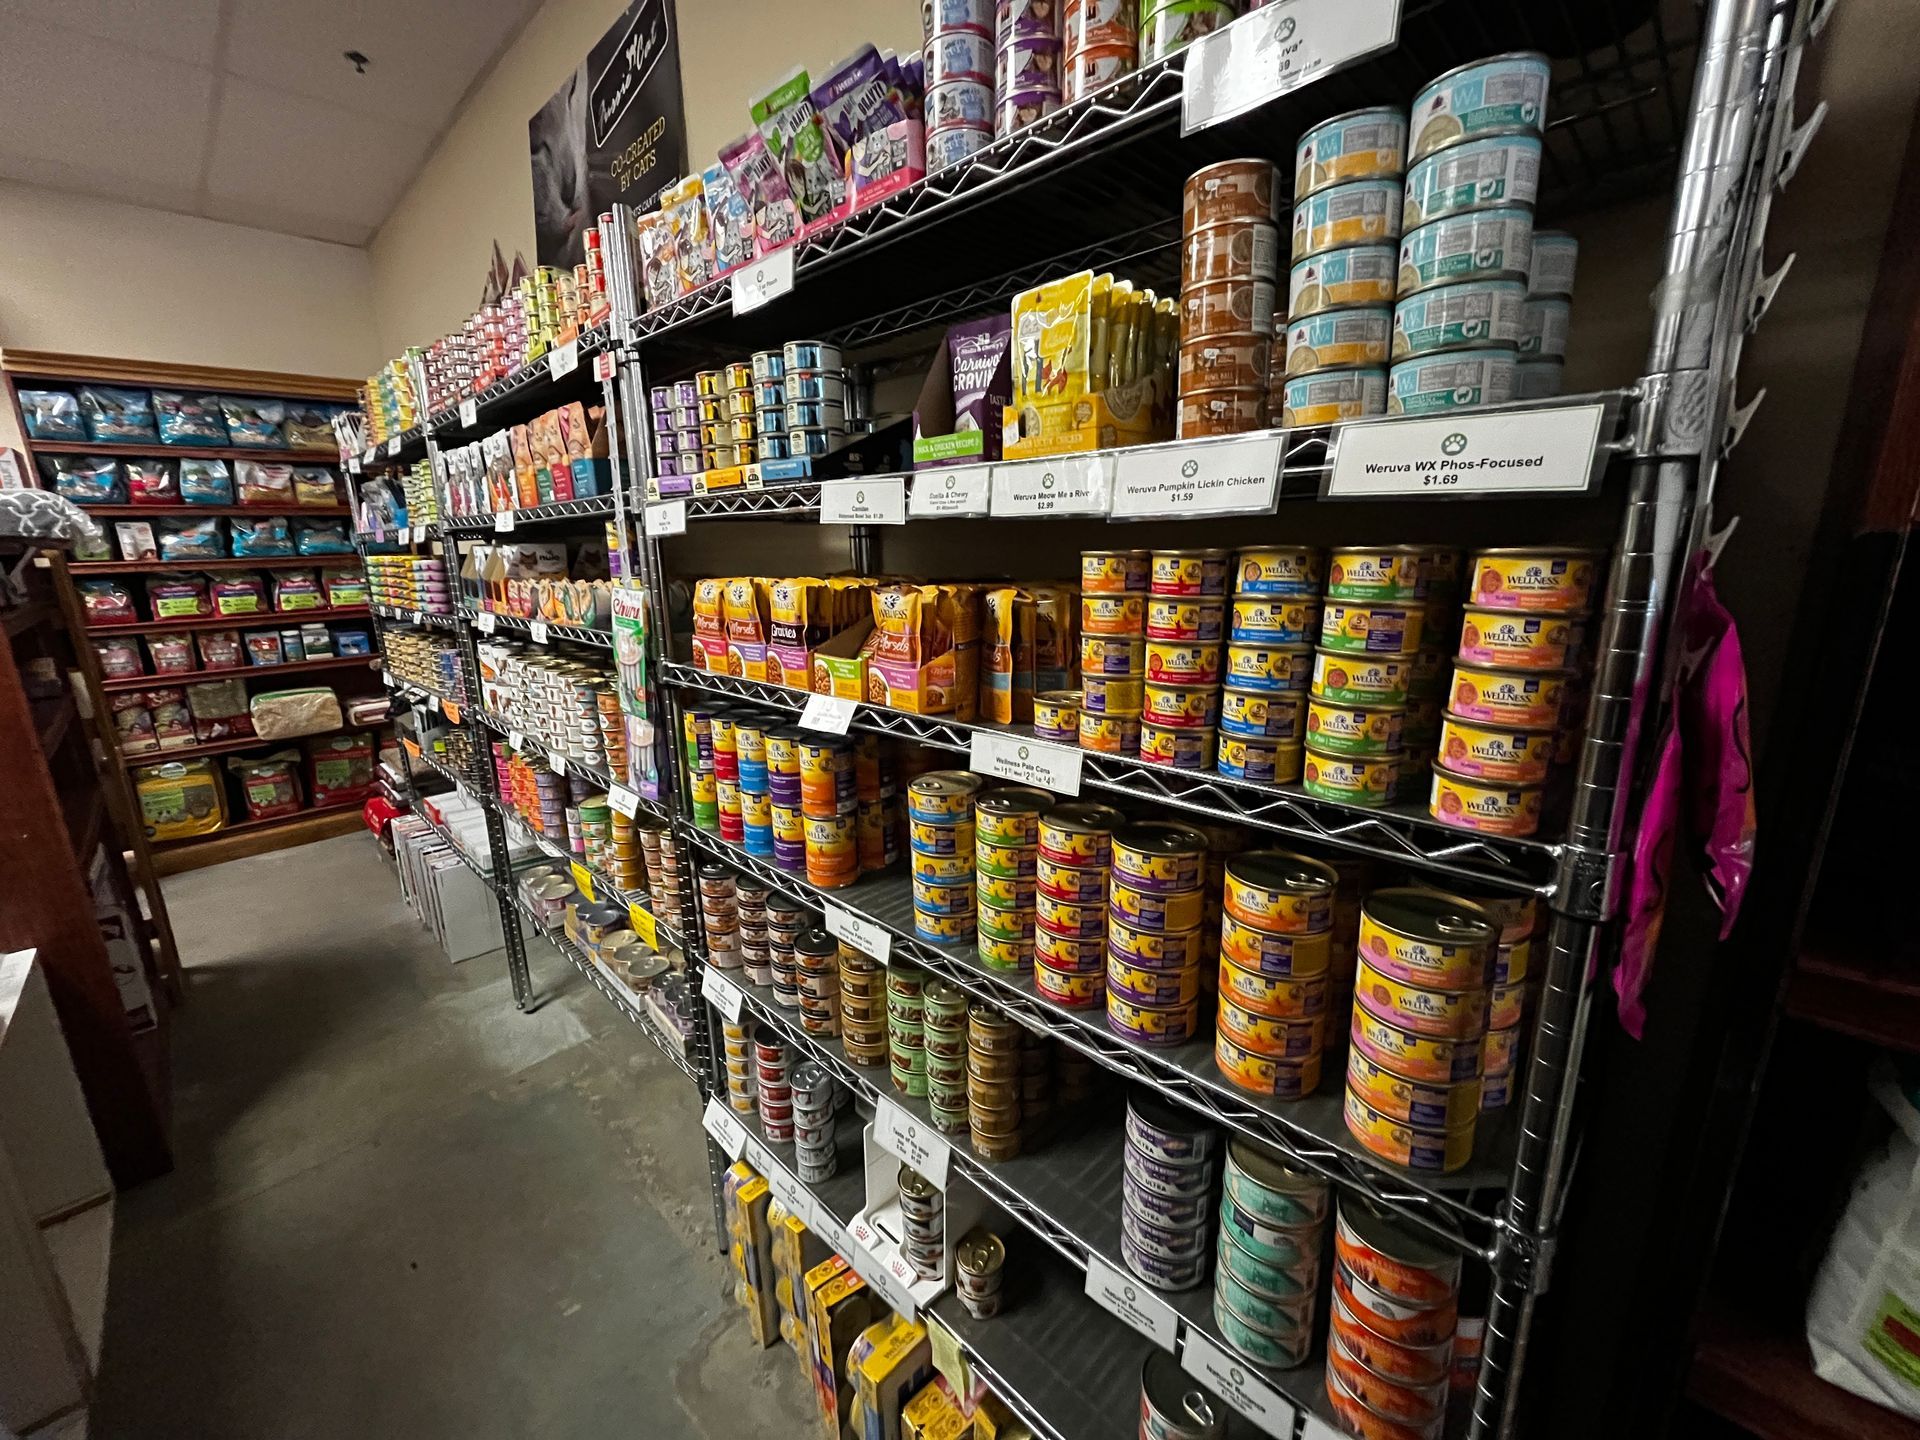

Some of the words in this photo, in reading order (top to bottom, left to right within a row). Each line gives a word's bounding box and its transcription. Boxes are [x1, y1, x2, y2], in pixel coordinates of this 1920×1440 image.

[611, 116, 666, 177] CO-CREATED
[621, 169, 632, 193] BY
[633, 149, 656, 181] CATS
[1365, 462, 1411, 474] Weruva
[1415, 461, 1436, 472] WX
[1440, 455, 1544, 471] Phos-Focused
[1127, 484, 1157, 494] Weruva
[1158, 481, 1195, 494] Pumpkin
[1197, 478, 1224, 489] Lickin
[1226, 475, 1265, 487] Chicken
[1423, 474, 1459, 486] $1.69
[1013, 491, 1037, 501] Weruva
[1038, 490, 1057, 500] Meow
[1058, 490, 1068, 498] Me
[1171, 493, 1194, 502] $1.59
[1037, 501, 1054, 510] $2.99
[1347, 569, 1388, 578] WELLNESS
[1507, 575, 1560, 586] WELLNESS
[613, 598, 640, 619] Churu
[878, 607, 908, 619] WELLNESS
[1243, 615, 1278, 623] WELLNESS
[880, 634, 910, 653] Morsels
[1483, 631, 1533, 644] WELLNESS
[1165, 659, 1198, 667] WELLNESS
[1352, 674, 1393, 684] WELLNESS
[1482, 690, 1532, 703] WELLNESS
[1323, 719, 1361, 732] WELLNESS
[1471, 745, 1520, 759] WELLNESS
[996, 757, 1020, 768] Wellness
[1321, 770, 1360, 783] WELLNESS
[1466, 801, 1516, 814] WELLNESS
[807, 828, 841, 840] WELLNESS
[1236, 891, 1270, 911] WELLNESS
[1395, 946, 1445, 966] WELLNESS
[1233, 976, 1268, 997] WELLNESS
[1399, 996, 1449, 1015] WELLNESS
[1366, 1026, 1407, 1054] WELLNESS
[1145, 1178, 1167, 1193] ULTRA
[1140, 1207, 1160, 1223] ULTRA
